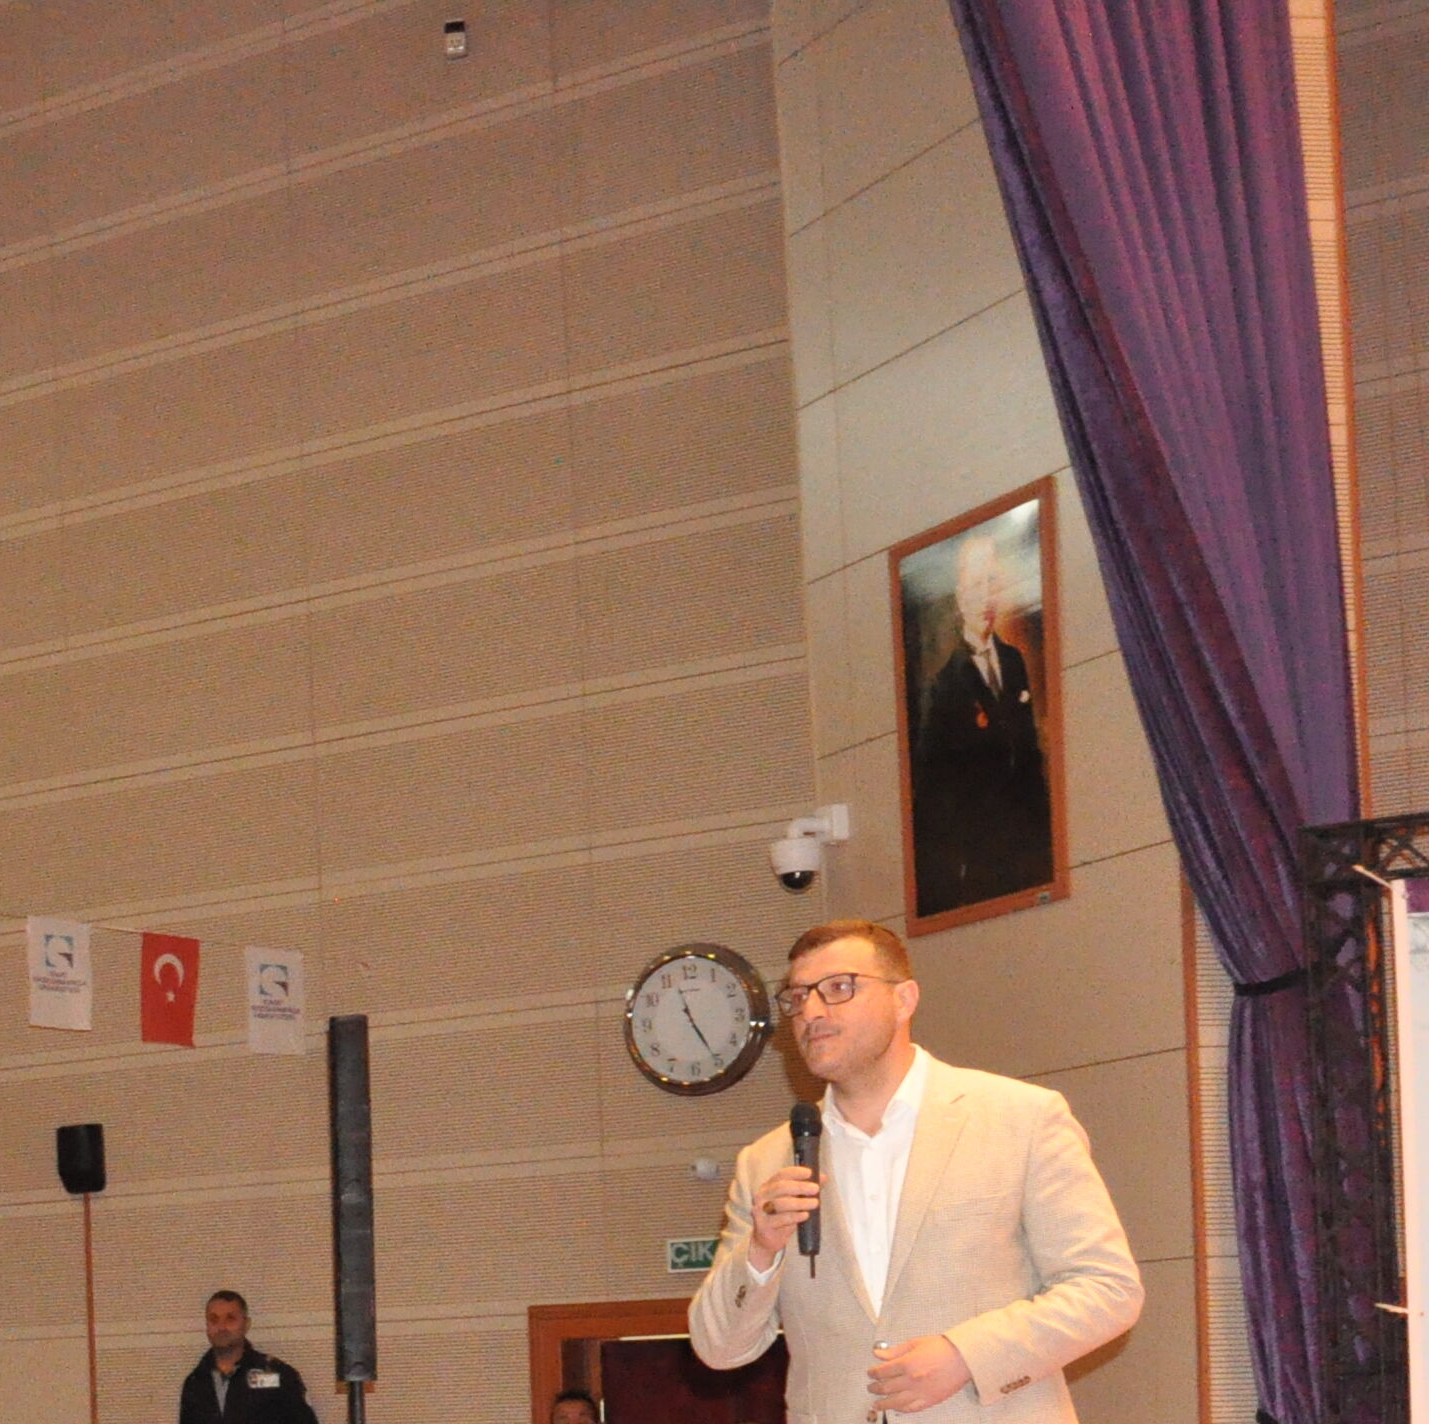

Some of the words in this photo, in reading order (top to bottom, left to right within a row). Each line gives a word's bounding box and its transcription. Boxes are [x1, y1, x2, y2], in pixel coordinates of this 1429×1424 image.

[682, 963, 697, 980] 12
[710, 967, 717, 983] 1
[661, 974, 672, 989] 11
[671, 1242, 714, 1267] ÇIK
